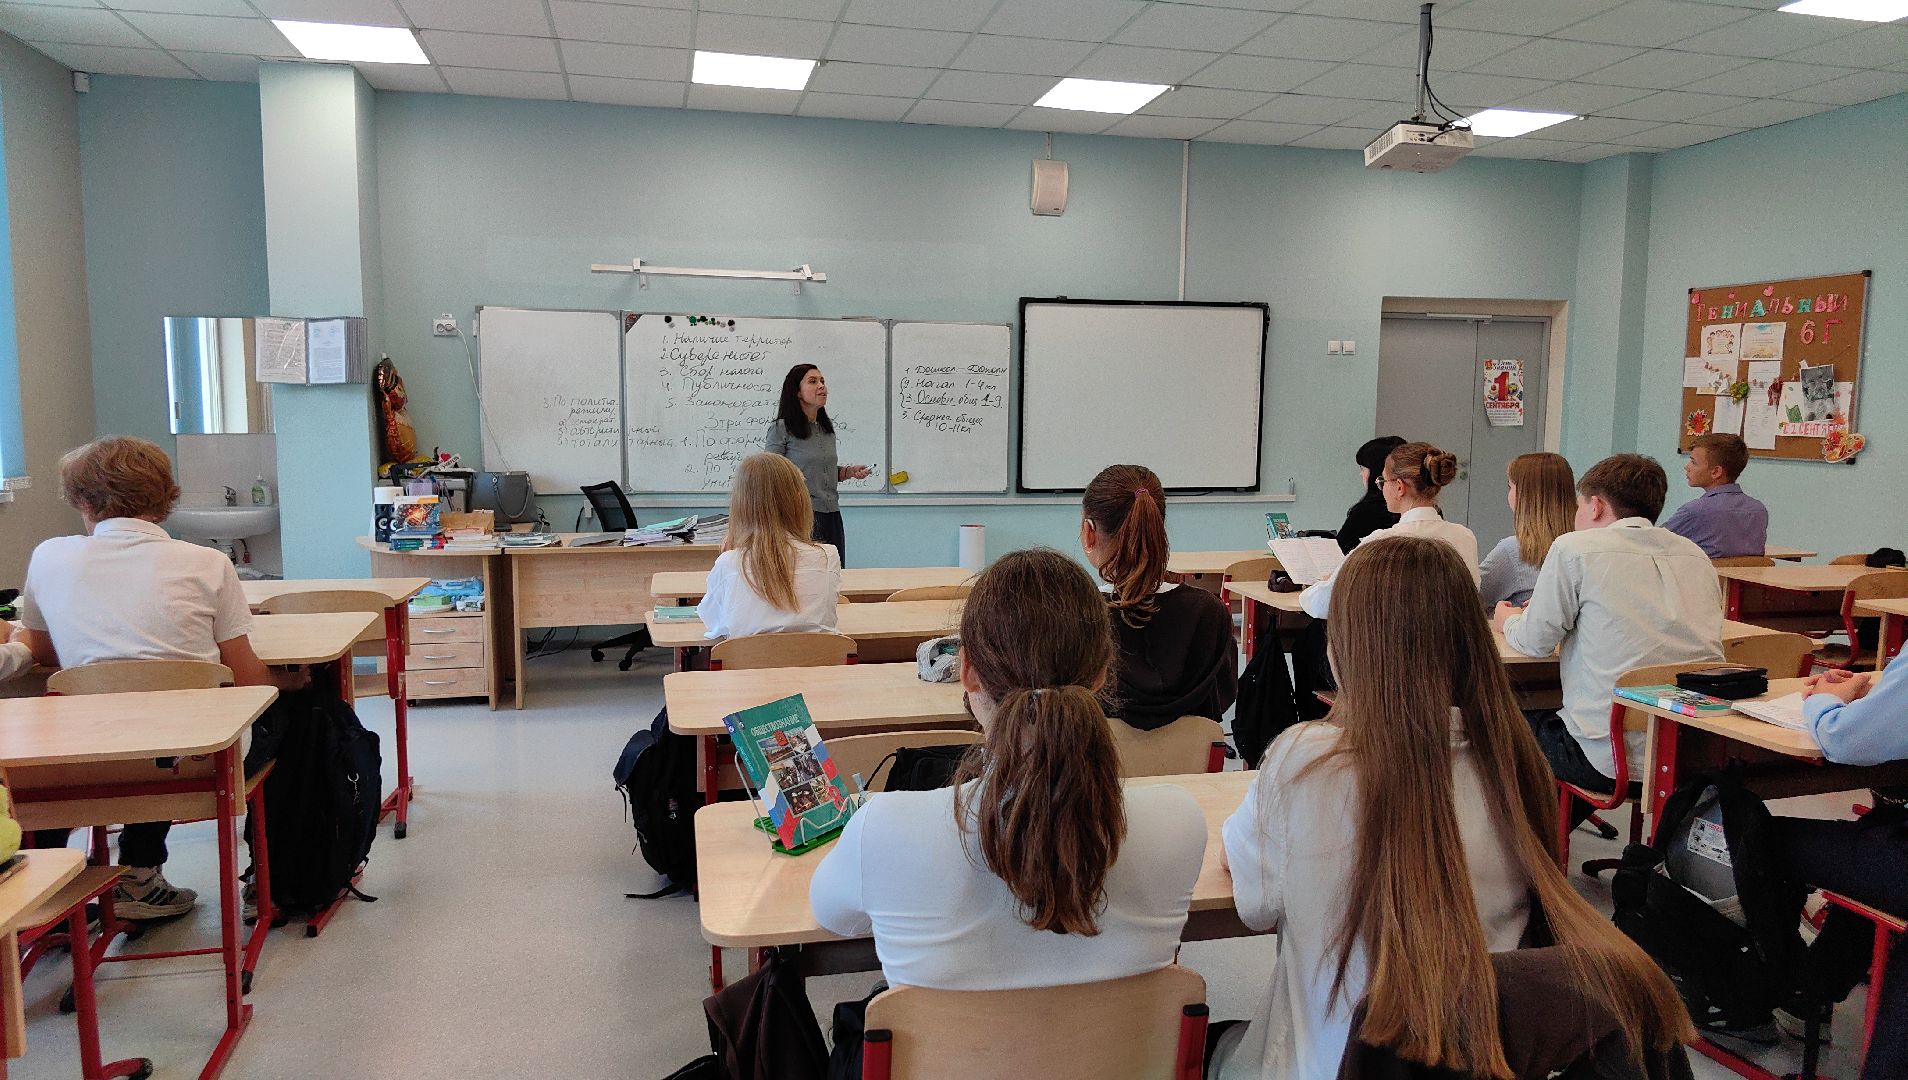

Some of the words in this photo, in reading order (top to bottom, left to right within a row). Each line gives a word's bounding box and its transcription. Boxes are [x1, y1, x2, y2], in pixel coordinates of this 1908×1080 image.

[673, 332, 729, 345] Наличие
[1800, 319, 1816, 345] 6
[1822, 319, 1841, 345] Г
[1494, 371, 1510, 401] 1
[1485, 401, 1520, 409] СЕНТЯБРЯ
[750, 713, 800, 737] ОБЩЕСТВОЗНАНИЕ
[828, 784, 848, 812] 8
